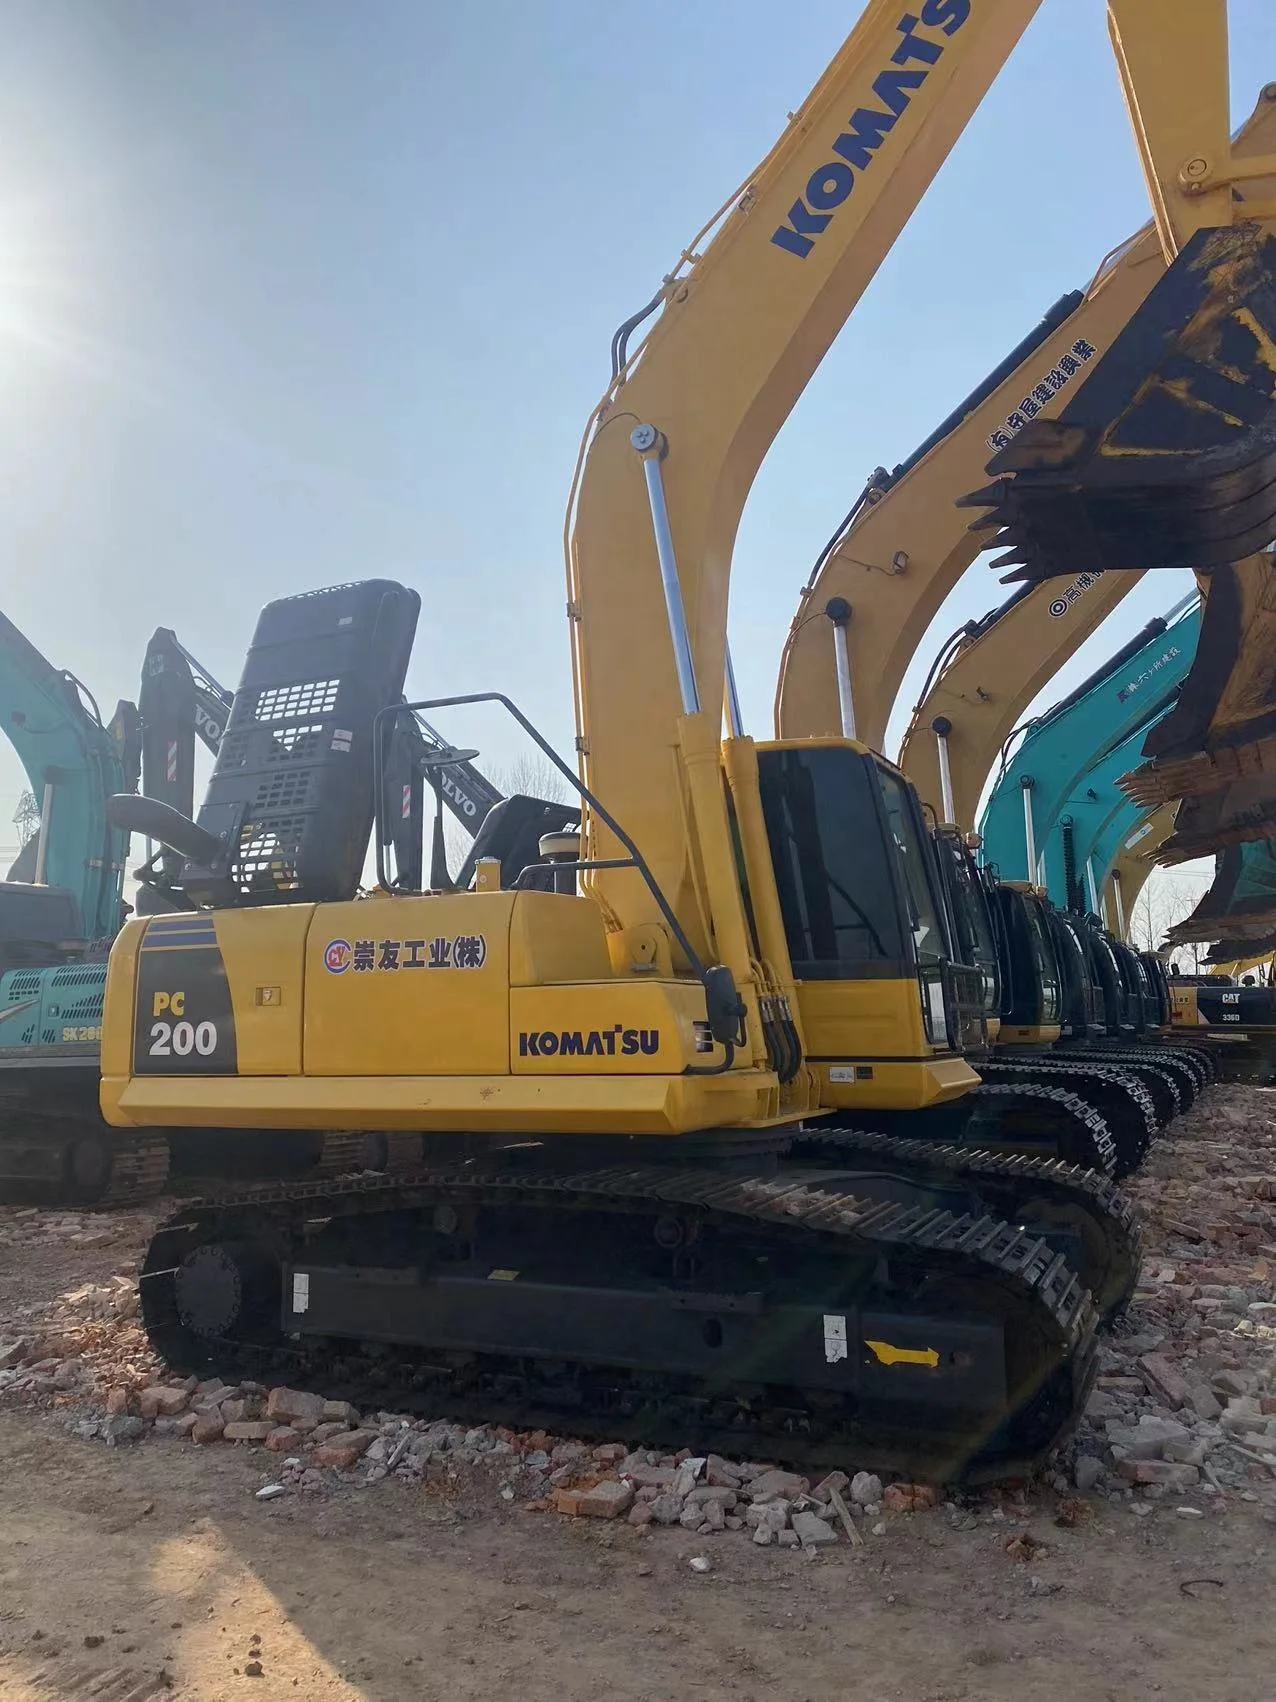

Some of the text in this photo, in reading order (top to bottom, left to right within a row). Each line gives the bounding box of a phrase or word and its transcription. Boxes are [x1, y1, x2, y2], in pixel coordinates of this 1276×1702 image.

[195, 703, 223, 746] VO
[153, 991, 185, 1017] PC
[1222, 993, 1240, 1004] CAT
[149, 1021, 218, 1056] 200
[519, 1024, 660, 1057] KOMATSU
